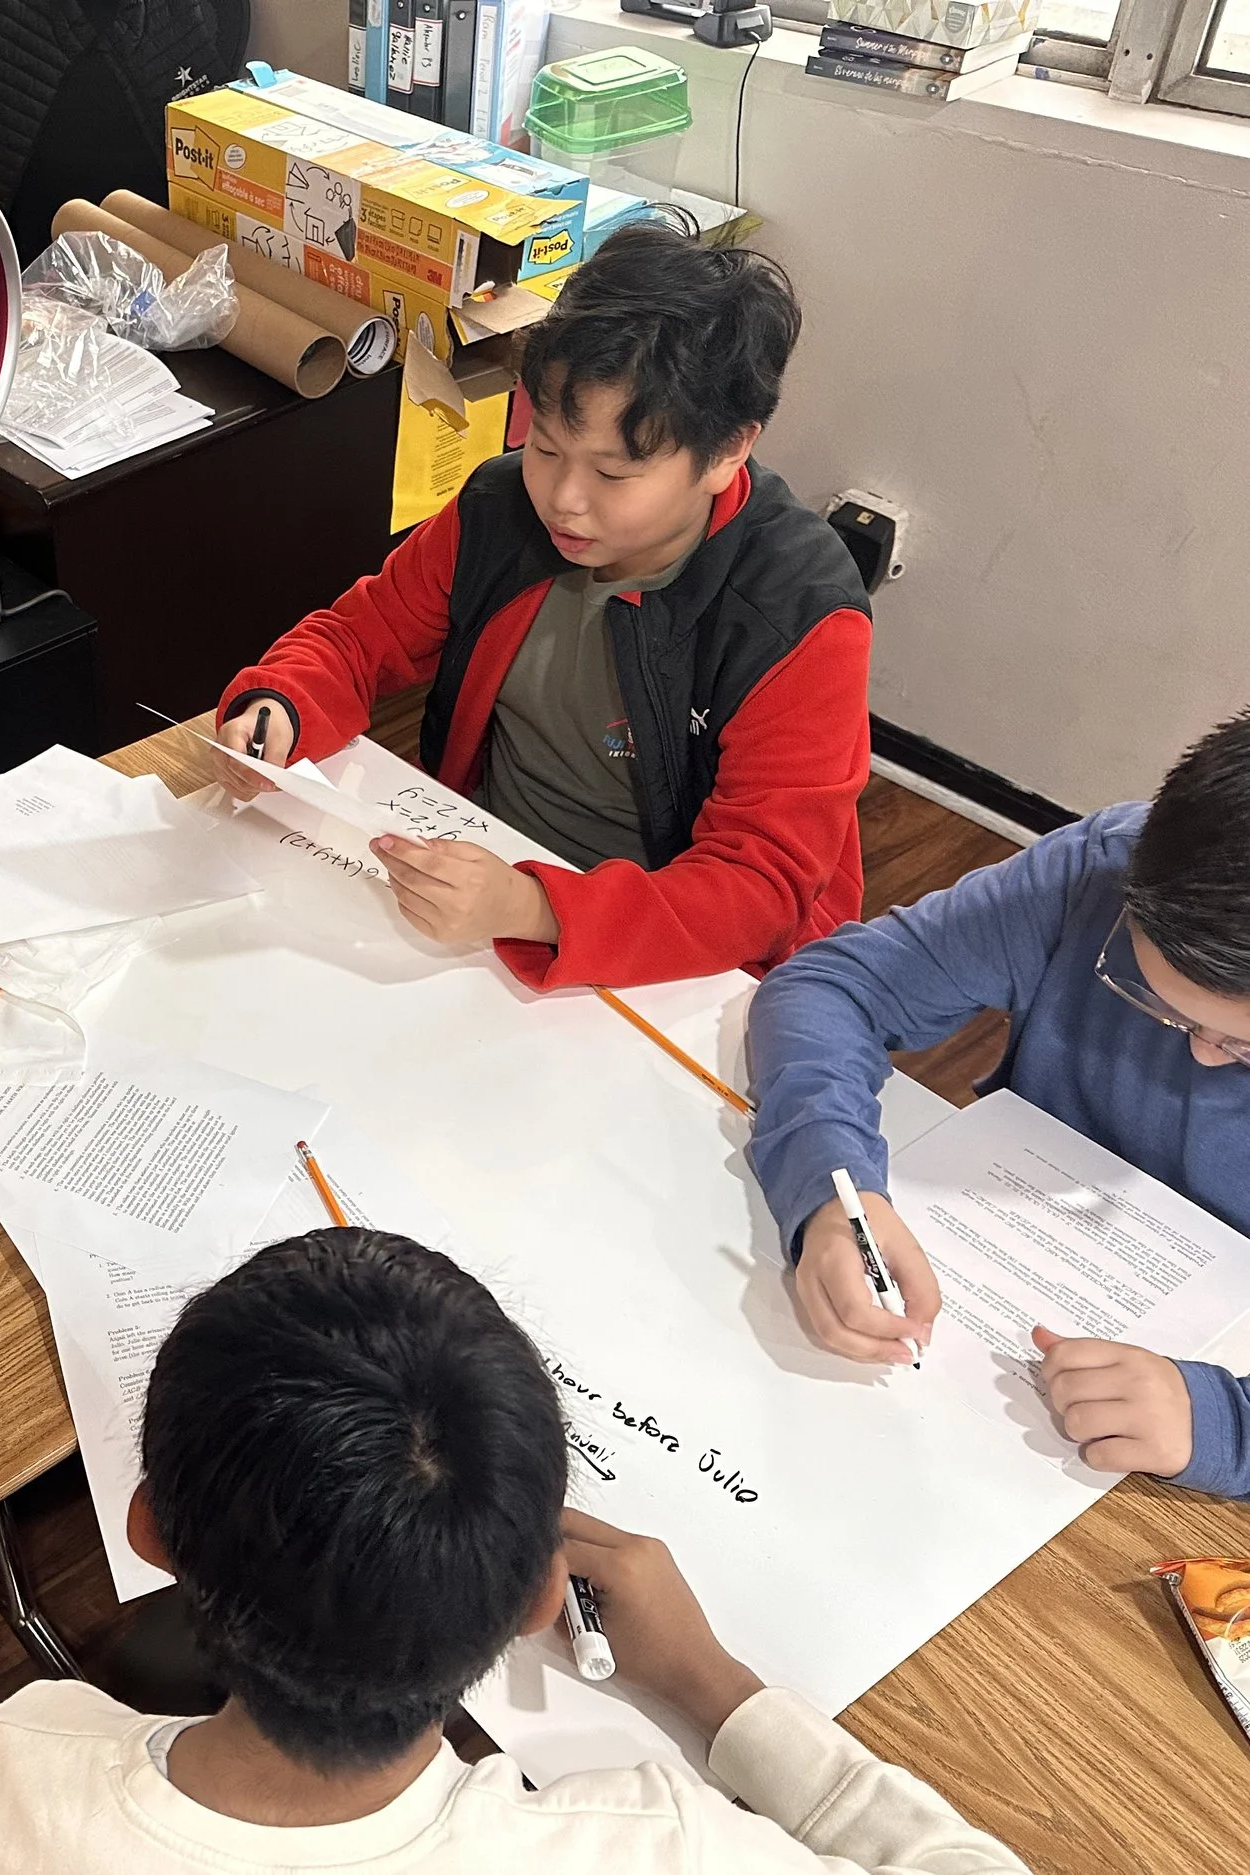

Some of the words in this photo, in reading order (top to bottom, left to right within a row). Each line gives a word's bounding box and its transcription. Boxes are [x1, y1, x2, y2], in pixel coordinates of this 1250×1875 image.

[175, 137, 214, 170] Post-it
[533, 239, 568, 260] Post-it
[427, 269, 443, 286] 3M
[551, 1363, 602, 1400] hour
[612, 1401, 680, 1453] before
[698, 1448, 758, 1503] Julio
